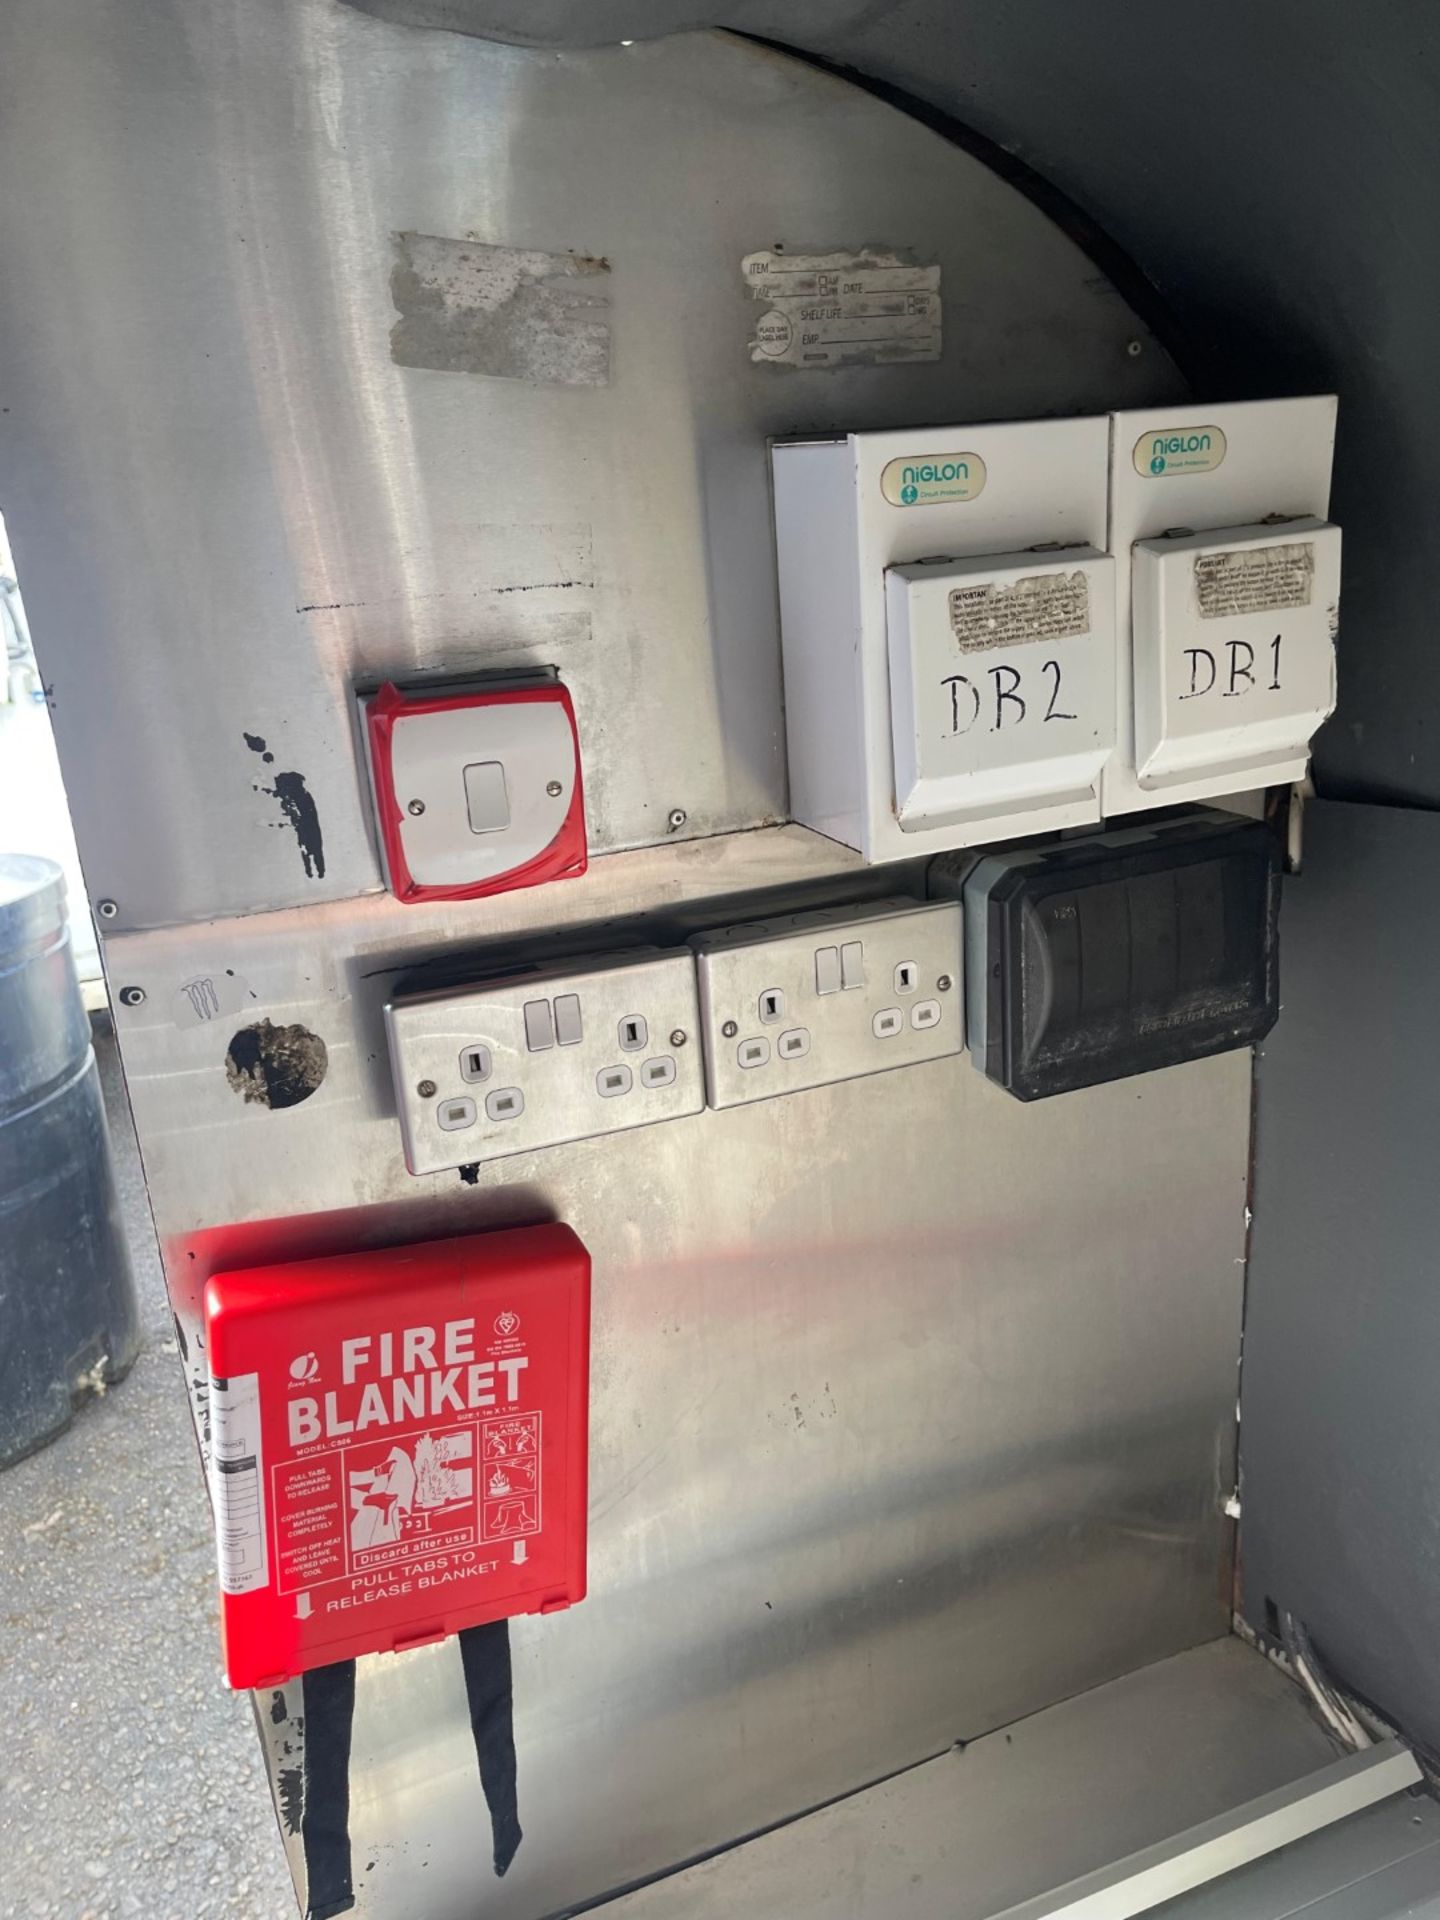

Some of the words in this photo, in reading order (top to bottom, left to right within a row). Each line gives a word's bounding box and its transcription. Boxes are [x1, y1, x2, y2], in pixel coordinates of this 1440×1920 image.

[750, 262, 769, 275] ITEM
[843, 282, 864, 295] DATE
[800, 309, 825, 320] SHELF
[826, 308, 842, 320] LIFE
[342, 1317, 476, 1386] FIRE
[287, 1356, 529, 1448] BLANKET
[284, 1474, 332, 1492] DOWNWARDS
[289, 1472, 307, 1483] PULL
[308, 1467, 326, 1478] TABS
[287, 1491, 297, 1500] TO
[298, 1483, 330, 1497] RELEASE
[281, 1509, 305, 1523] COVER
[306, 1502, 338, 1516] BURNING
[293, 1514, 327, 1529] MATERIAL
[287, 1520, 333, 1538] COMPLETELY
[281, 1546, 308, 1559] SWITCH
[308, 1542, 322, 1551] OFF
[323, 1536, 341, 1547] HEAT
[293, 1554, 307, 1564] AND
[309, 1548, 331, 1559] LEAVE
[359, 1545, 409, 1565] Discard
[413, 1536, 442, 1552] after
[445, 1532, 467, 1544] use
[284, 1560, 318, 1575] COVERED
[320, 1555, 339, 1566] UNTIL
[303, 1568, 322, 1578] COOL
[351, 1571, 398, 1590] PULL
[401, 1557, 448, 1577] TABS
[452, 1550, 476, 1565] TO
[326, 1581, 412, 1613] RELEASE
[418, 1559, 500, 1590] BLANKET
